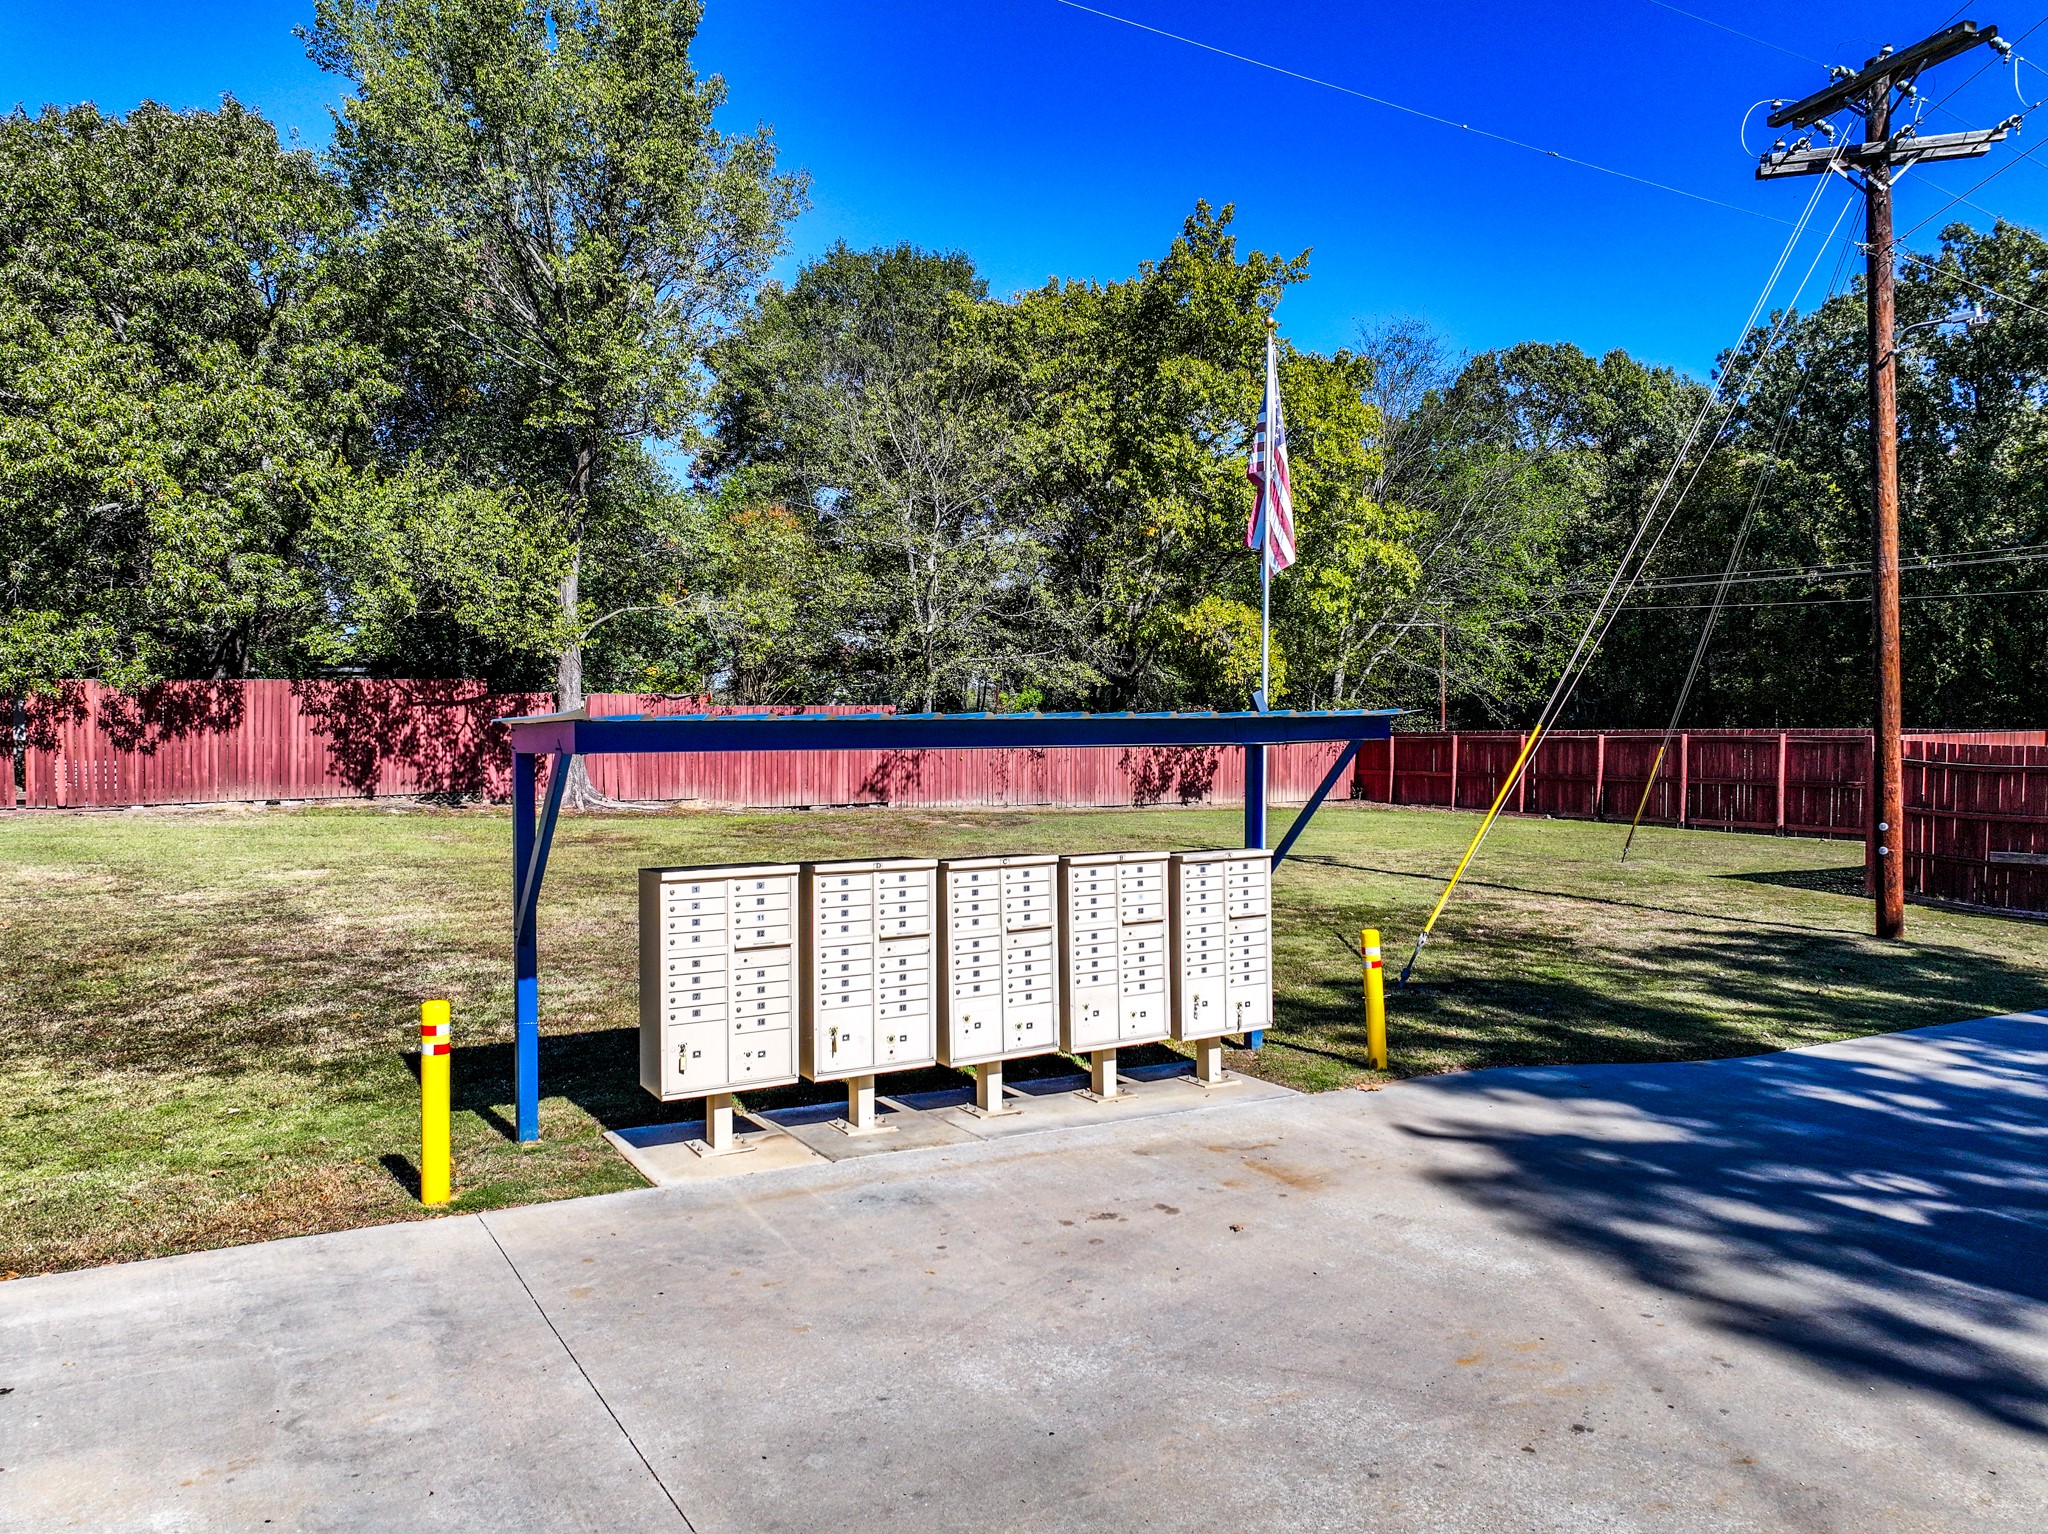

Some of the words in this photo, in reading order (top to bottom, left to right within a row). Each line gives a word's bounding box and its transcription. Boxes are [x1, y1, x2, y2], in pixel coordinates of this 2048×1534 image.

[693, 902, 699, 910] 2
[693, 935, 699, 943] 4
[842, 948, 848, 956] 5
[693, 976, 699, 984] 6
[842, 979, 848, 987] 7
[757, 986, 765, 994] 14
[757, 1002, 765, 1010] 15
[693, 1009, 700, 1017] 8
